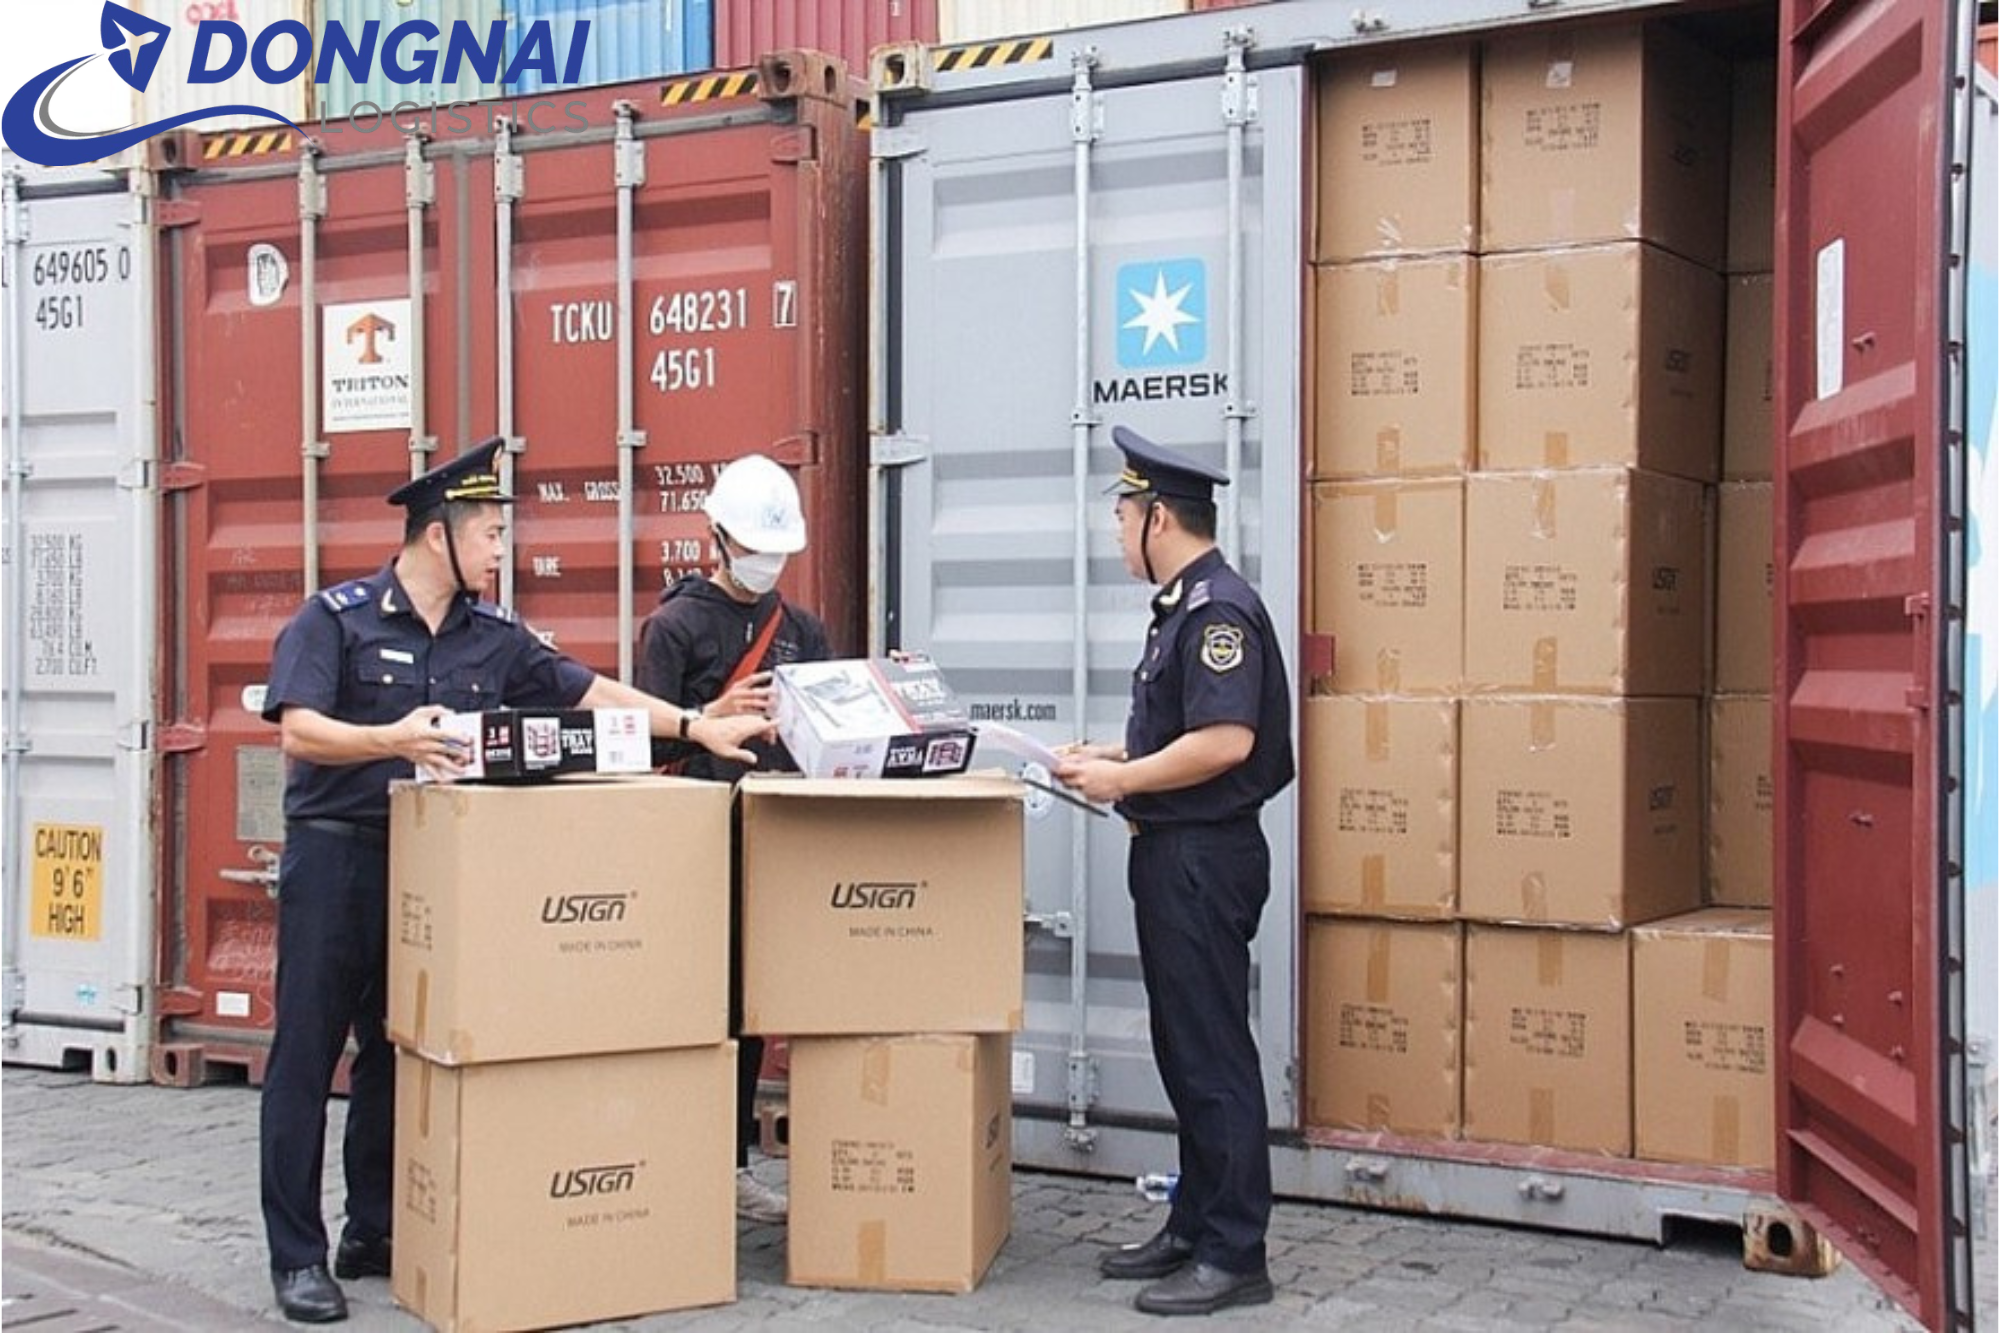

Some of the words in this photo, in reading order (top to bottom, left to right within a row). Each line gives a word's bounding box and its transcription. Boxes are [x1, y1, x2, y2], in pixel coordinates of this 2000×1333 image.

[34, 249, 109, 286] 649605
[119, 246, 131, 281] 0
[35, 294, 83, 331] 45G1
[550, 301, 613, 343] TCKU
[649, 288, 747, 335] 648231
[775, 283, 794, 326] 7
[650, 347, 715, 392] 45G1
[1093, 372, 1228, 404] MAERSK
[970, 698, 1056, 721] maersk.com
[35, 829, 103, 862] CAUTION
[48, 904, 85, 936] HIGH
